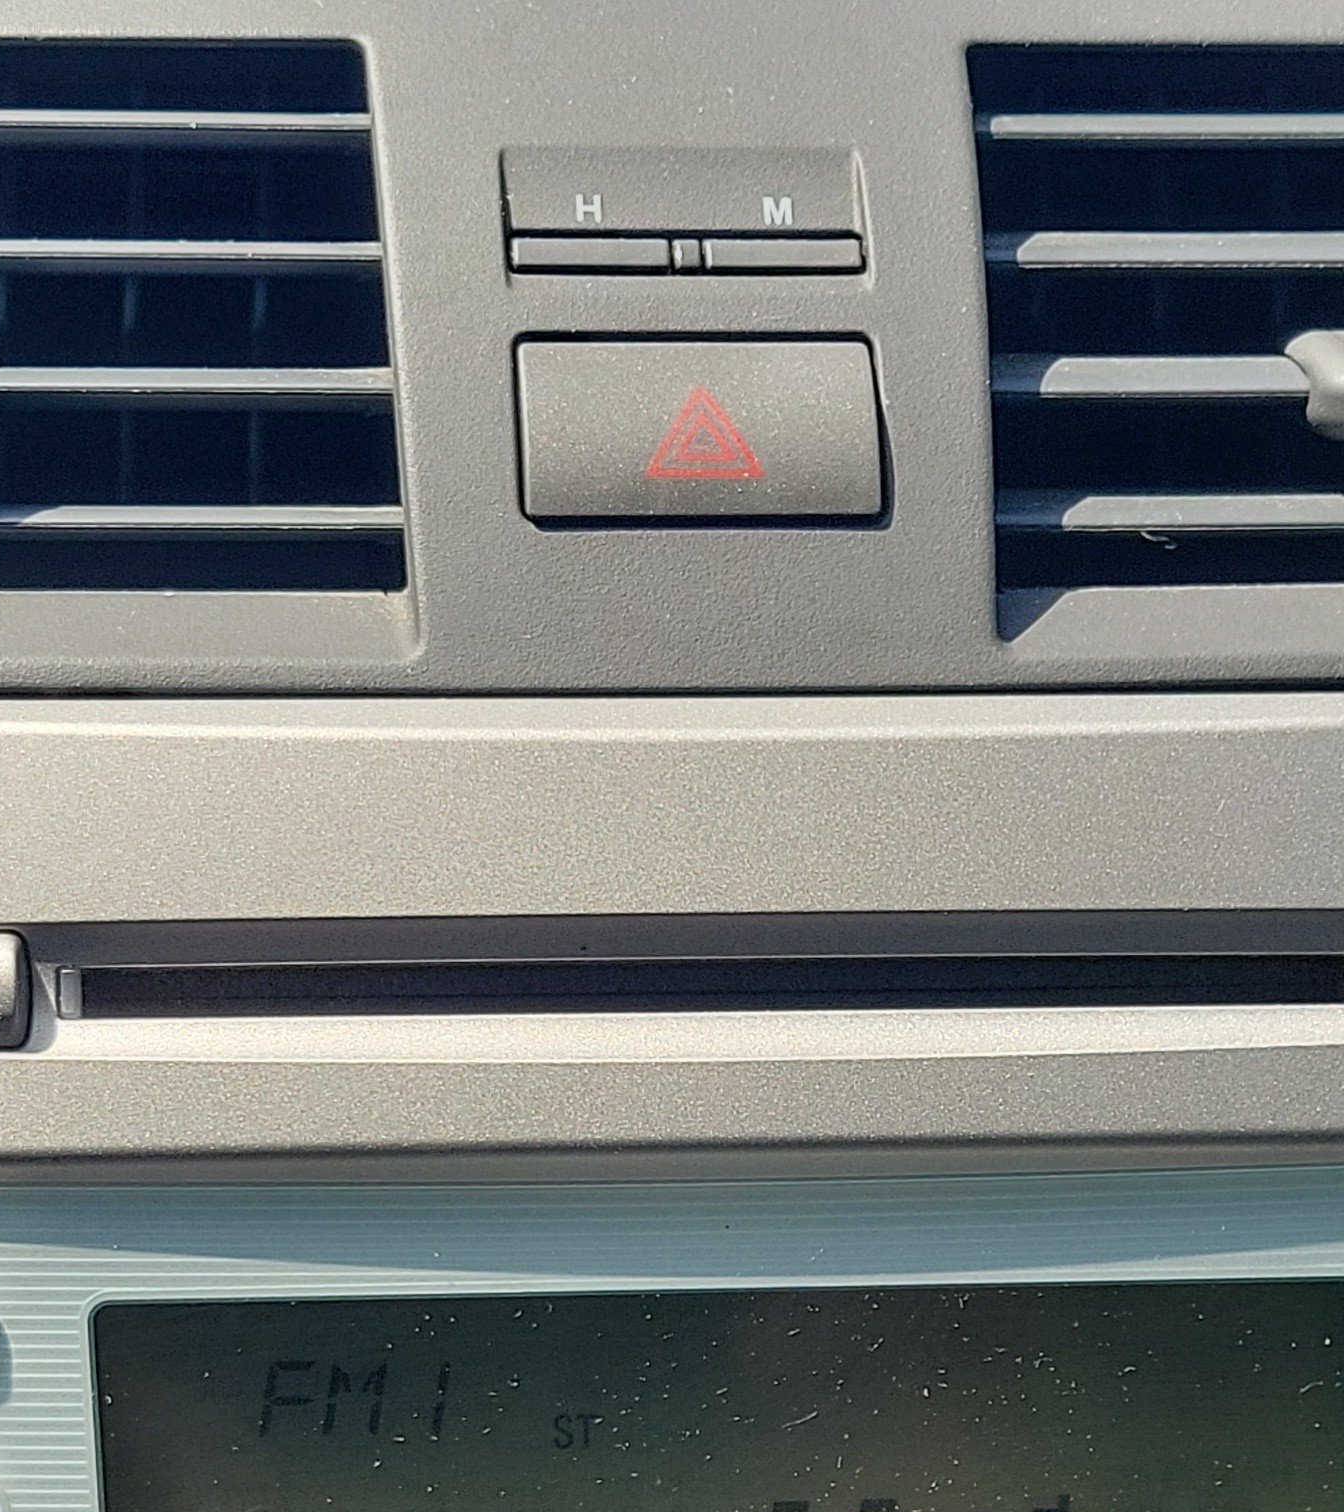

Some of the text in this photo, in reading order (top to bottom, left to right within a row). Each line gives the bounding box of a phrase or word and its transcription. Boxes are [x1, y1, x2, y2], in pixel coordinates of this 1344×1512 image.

[575, 193, 603, 223] H
[762, 196, 793, 225] M
[555, 1414, 600, 1449] ST
